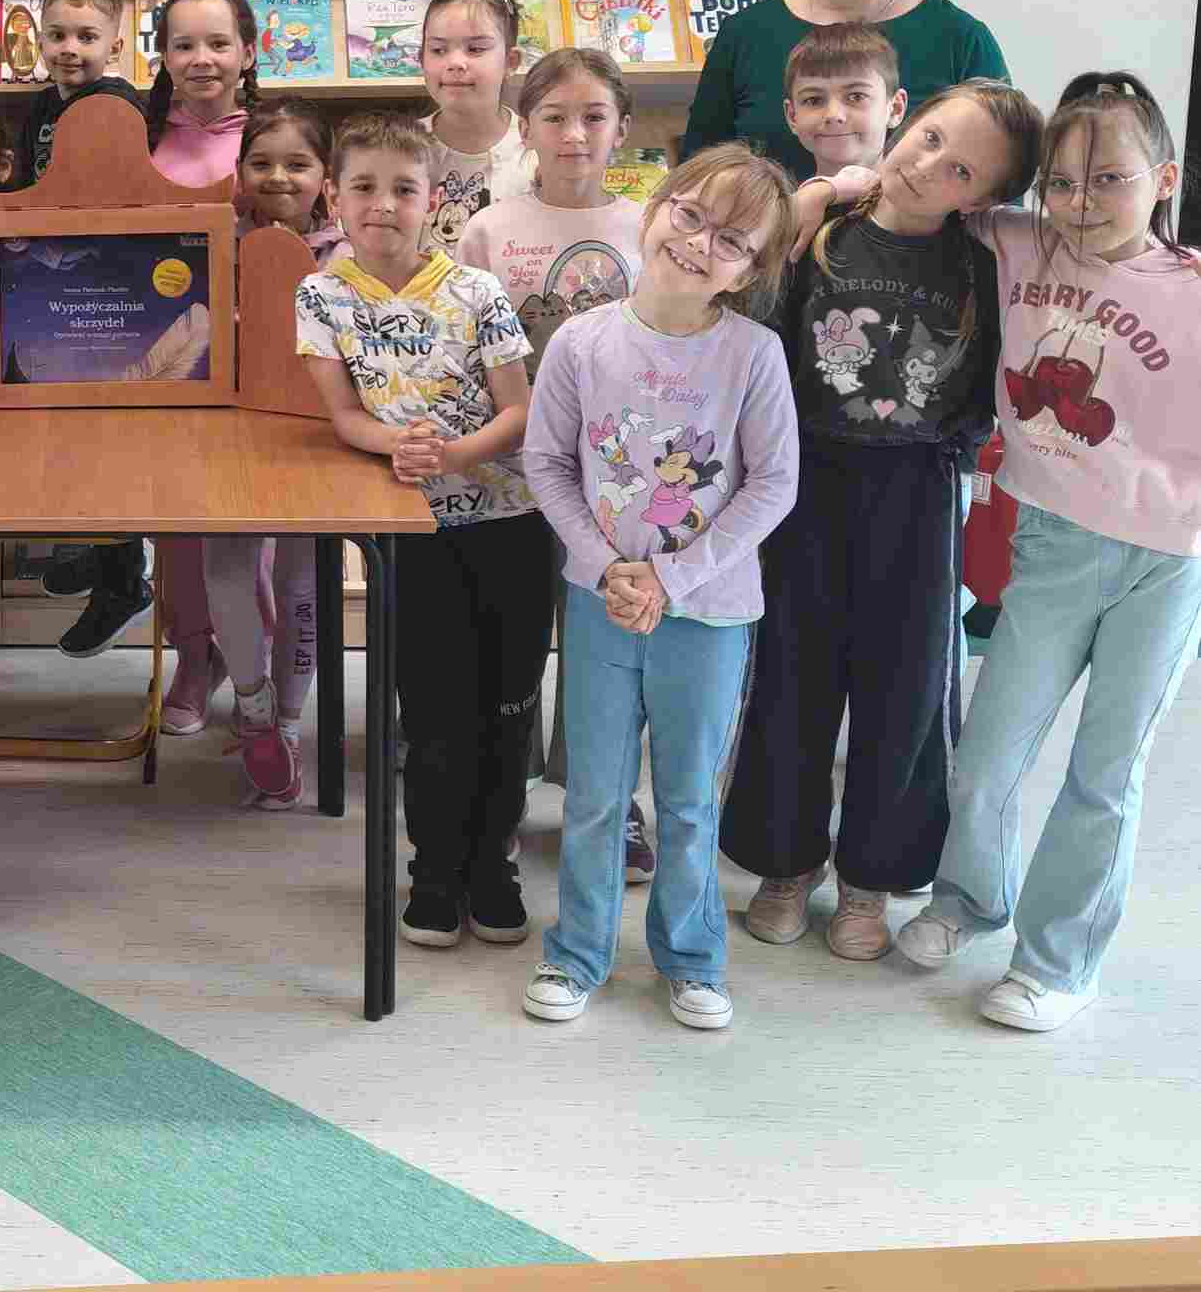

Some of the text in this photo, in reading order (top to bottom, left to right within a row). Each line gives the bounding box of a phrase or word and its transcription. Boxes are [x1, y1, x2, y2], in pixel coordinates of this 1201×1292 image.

[502, 239, 555, 258] Sweet
[832, 278, 910, 294] MELODY
[47, 300, 146, 315] Wypożyczalnia
[69, 316, 125, 331] skrzydeł
[1095, 298, 1171, 372] GOOD
